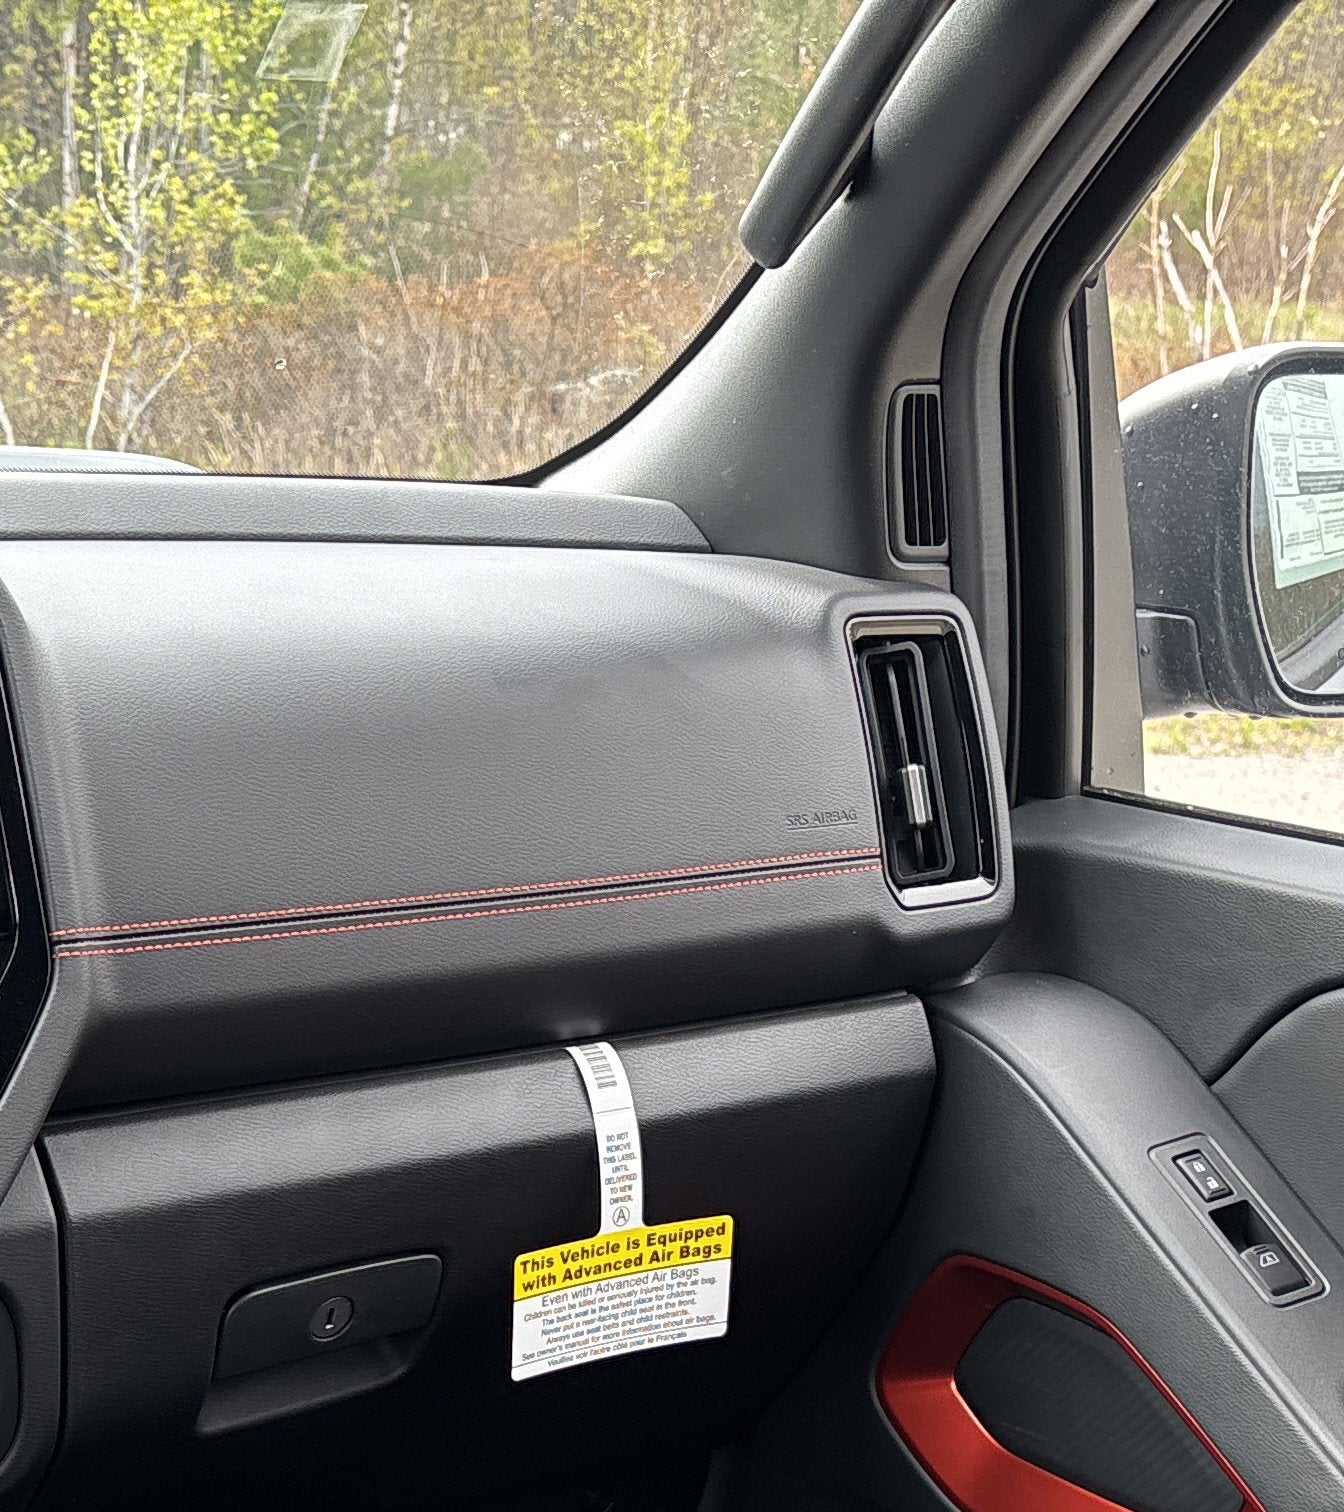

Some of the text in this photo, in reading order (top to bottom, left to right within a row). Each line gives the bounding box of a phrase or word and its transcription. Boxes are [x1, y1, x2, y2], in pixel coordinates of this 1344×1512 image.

[813, 809, 858, 825] AIRBAG
[520, 1222, 726, 1275] This Vehicle is Equipped
[522, 1243, 723, 1292] with Advanced Air Bags
[524, 1309, 553, 1322] Children
[640, 1283, 664, 1296] injured
[666, 1282, 675, 1292] by
[676, 1280, 688, 1289] the
[690, 1278, 699, 1287] air
[542, 1267, 700, 1308] Even with Advanced Air Bags
[556, 1313, 572, 1323] back
